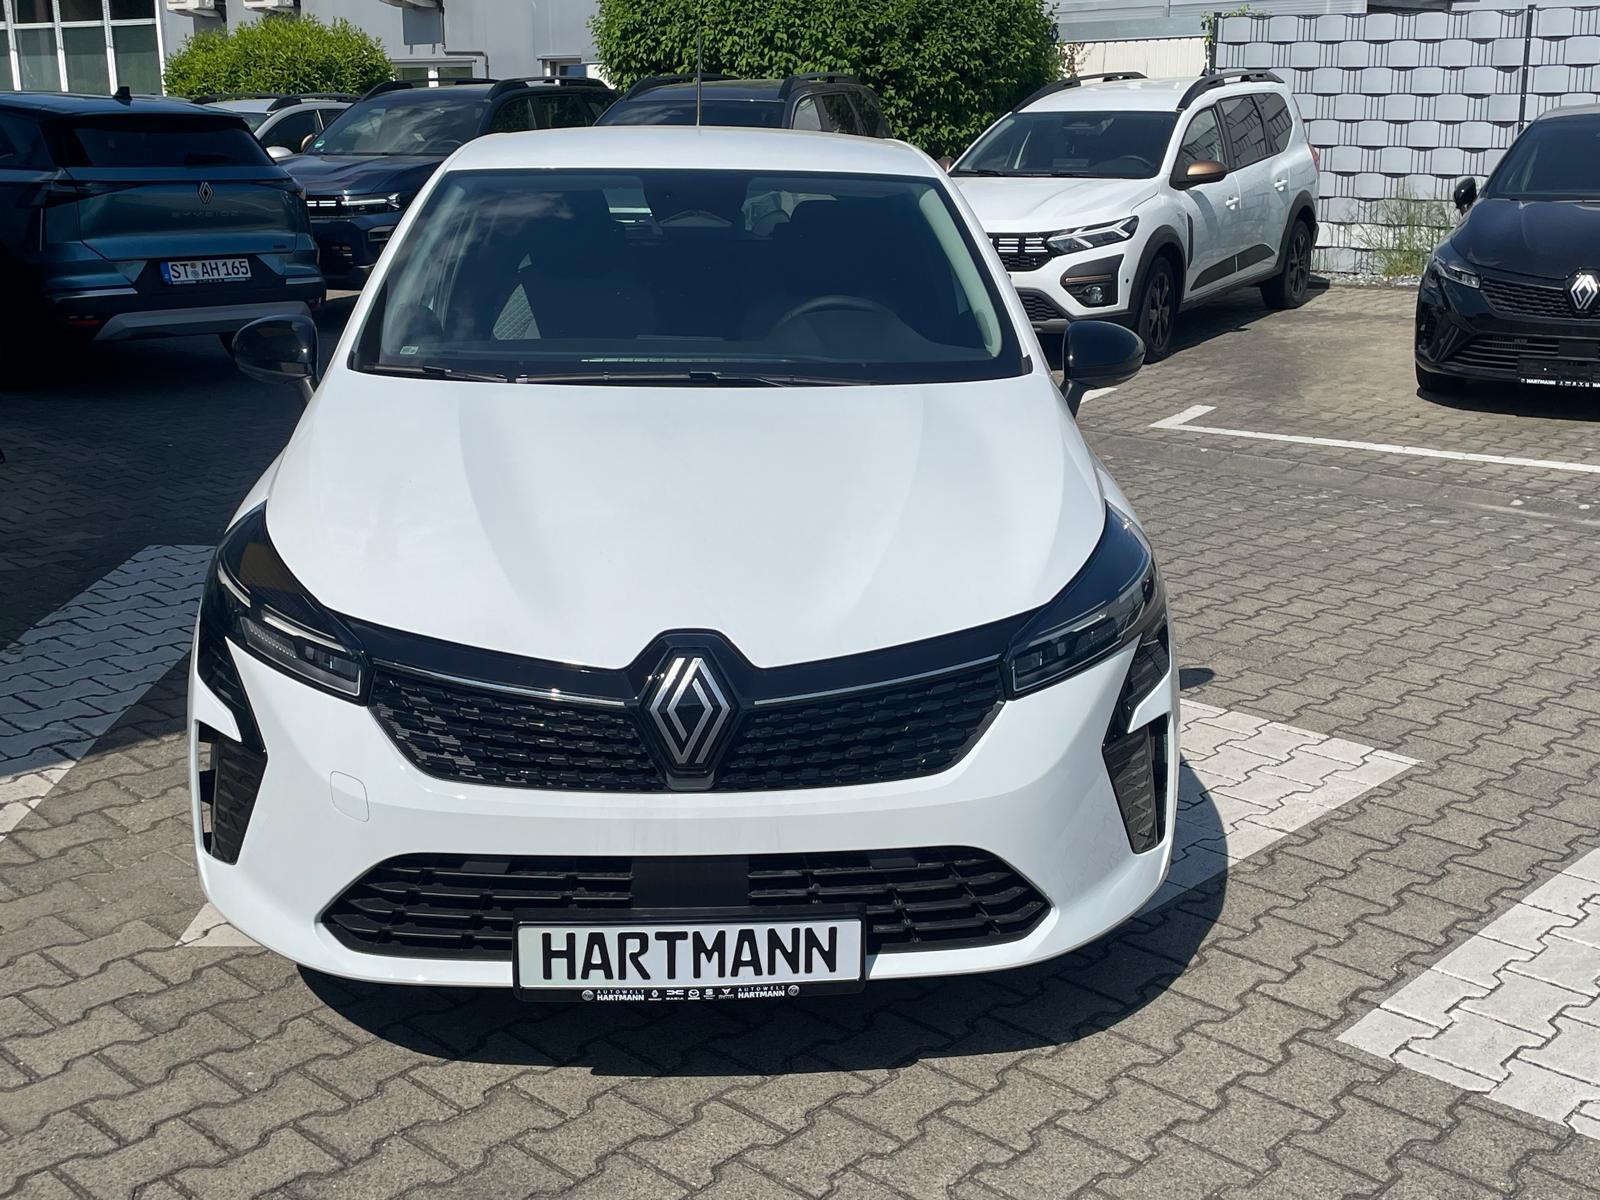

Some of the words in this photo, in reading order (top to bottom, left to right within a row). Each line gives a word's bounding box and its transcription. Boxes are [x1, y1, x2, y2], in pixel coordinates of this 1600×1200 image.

[170, 263, 189, 279] ST
[201, 262, 221, 277] AH
[222, 261, 249, 276] 165
[541, 926, 838, 981] HARTMANN
[738, 990, 785, 998] HARTMANN
